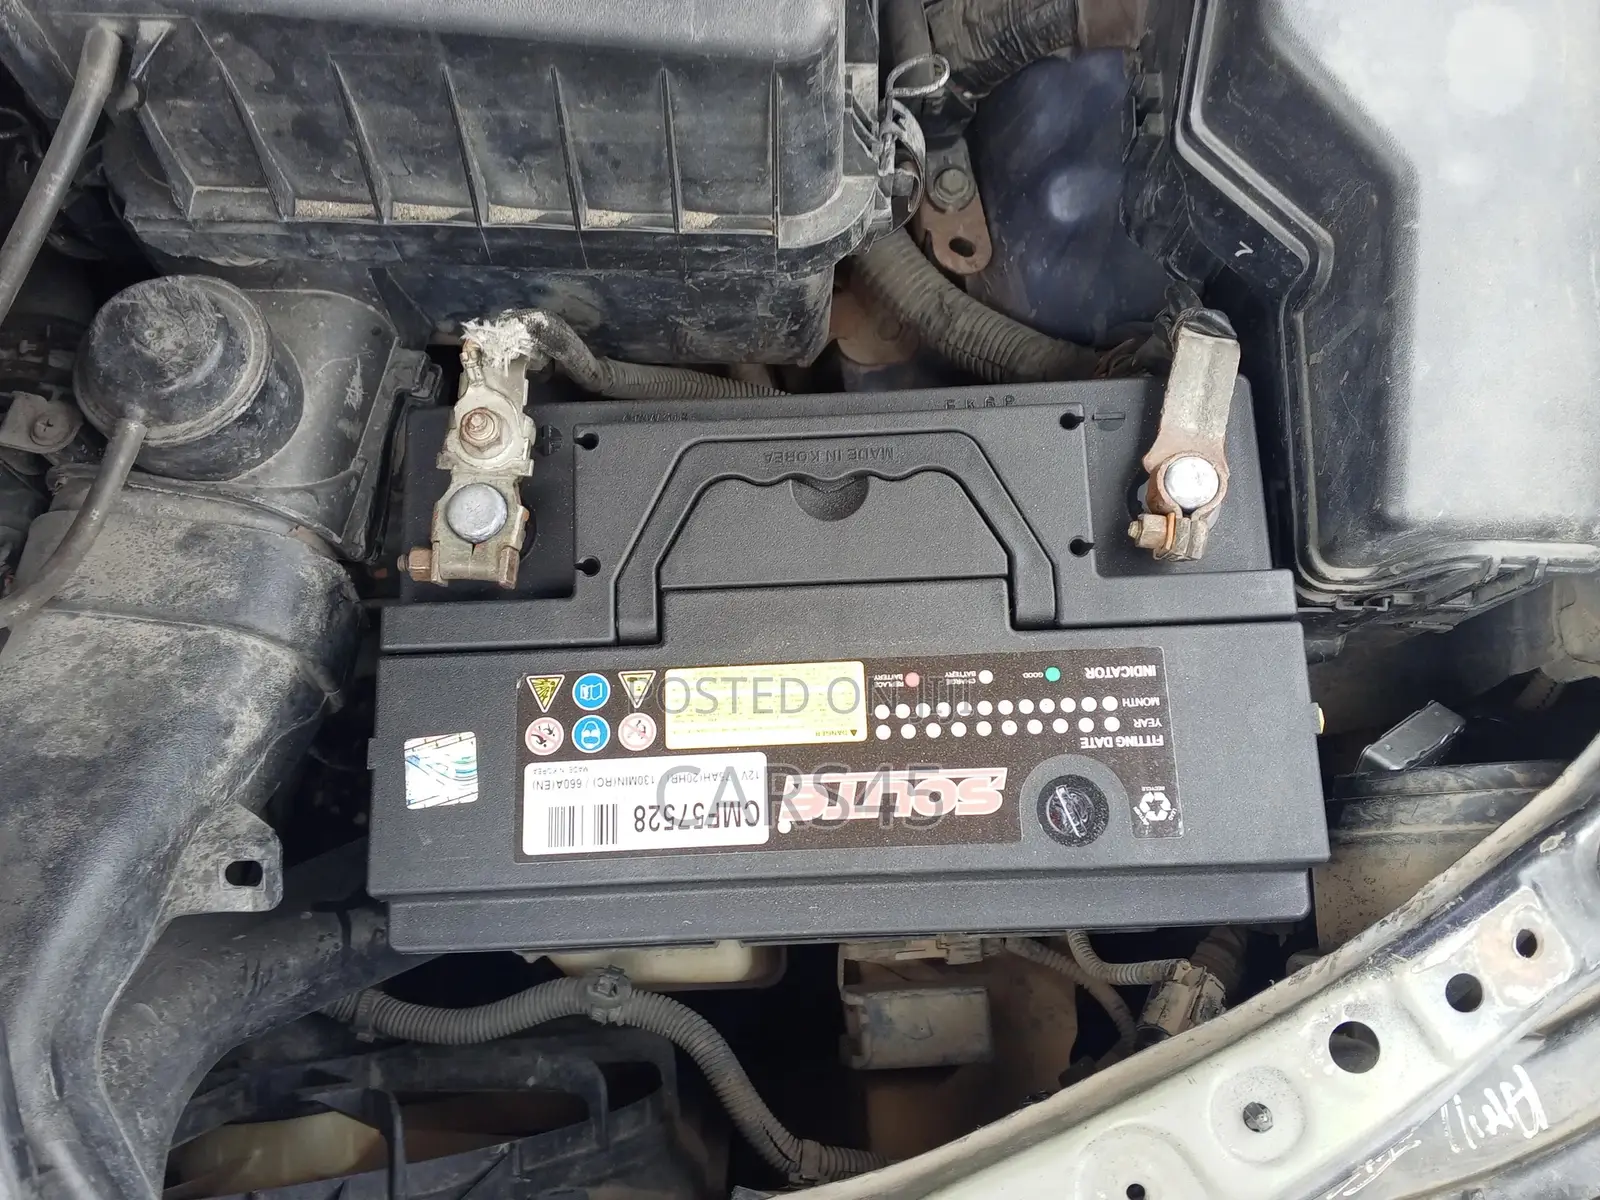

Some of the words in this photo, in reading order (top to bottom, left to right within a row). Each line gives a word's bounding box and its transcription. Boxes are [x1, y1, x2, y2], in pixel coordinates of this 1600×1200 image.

[763, 450, 820, 464] KOREA
[825, 450, 842, 462] IN
[847, 447, 894, 462] MADE
[1084, 665, 1157, 679] INDICATOR
[1122, 697, 1160, 708] MONTH
[1133, 718, 1163, 728] YEAR
[1079, 736, 1113, 749] DATE
[1115, 734, 1165, 748] FITTING
[741, 770, 760, 781] 12V
[532, 779, 582, 790] 660A(EN)
[634, 800, 760, 833] CMF57528
